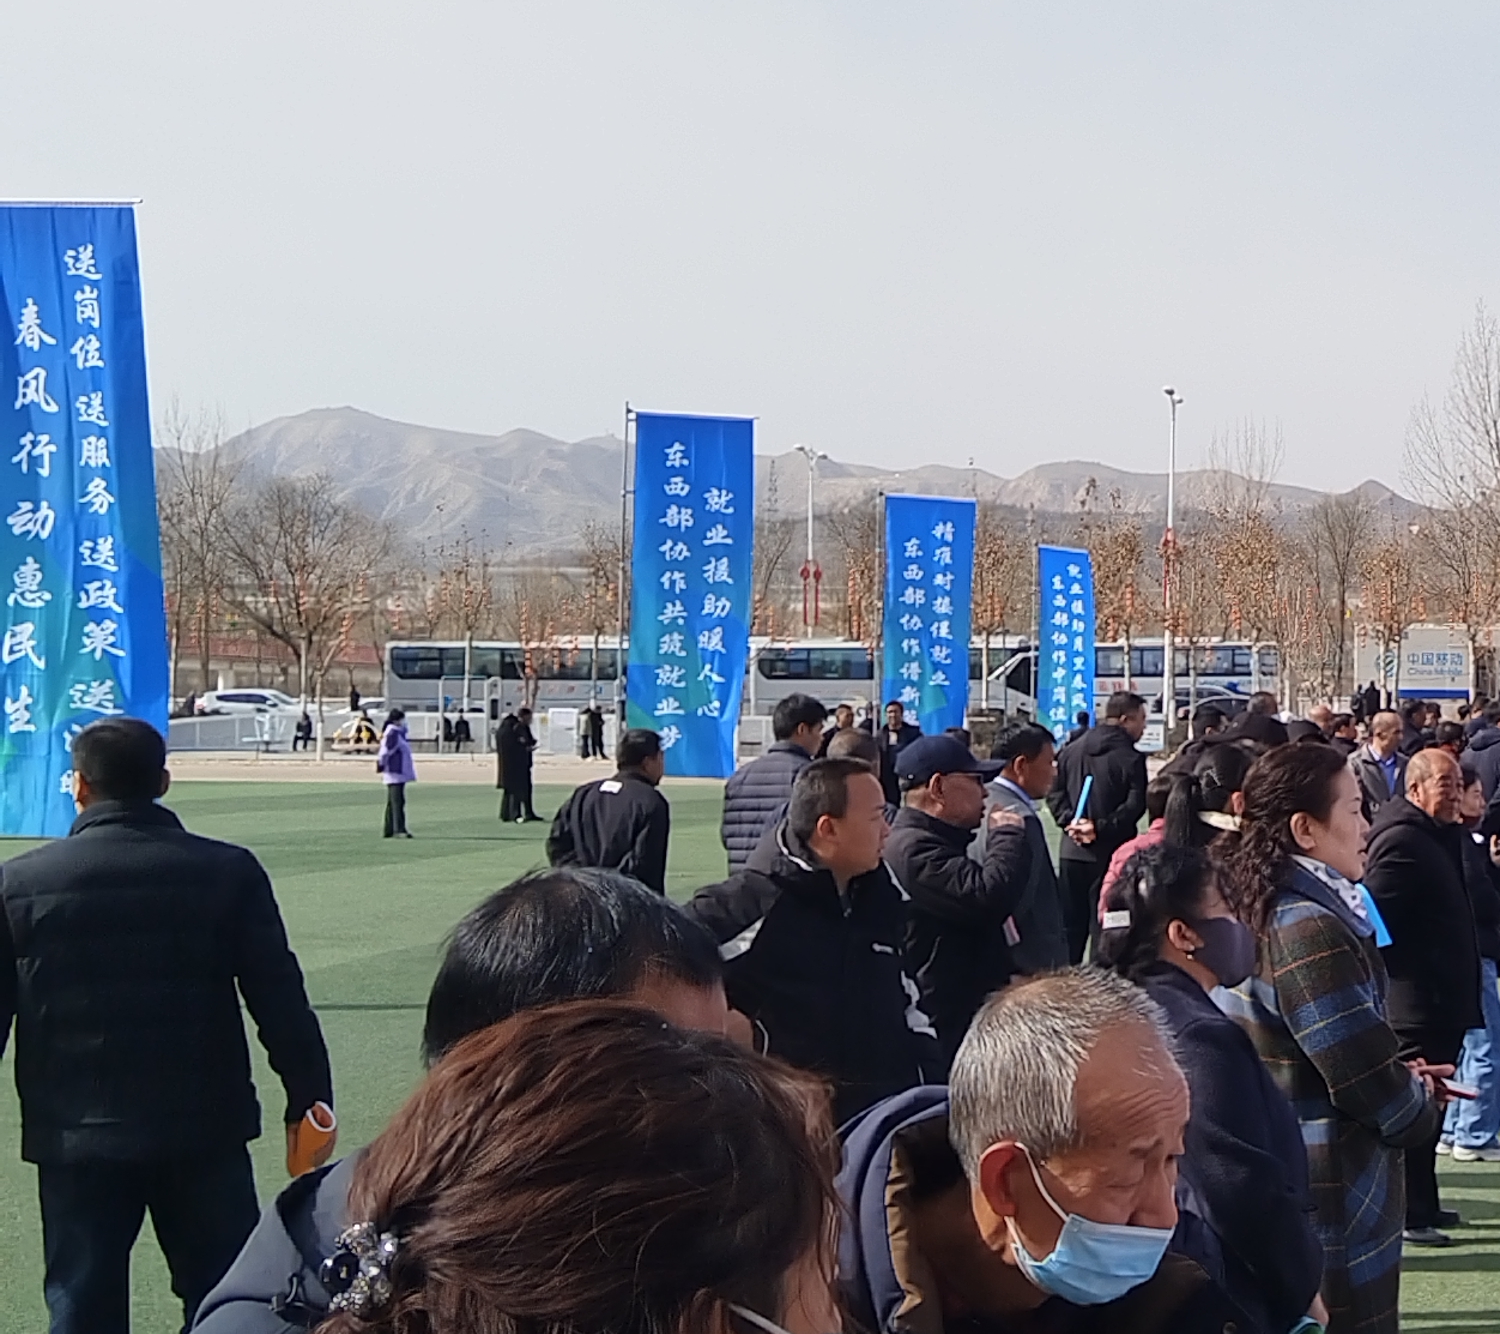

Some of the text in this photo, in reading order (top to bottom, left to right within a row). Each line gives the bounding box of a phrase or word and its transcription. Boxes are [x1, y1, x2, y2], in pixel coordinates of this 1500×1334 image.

[63, 242, 105, 372] 送岗位
[2, 297, 59, 735] 春风行动惠民生
[74, 390, 117, 517] 送服务
[74, 536, 127, 663] 送政策
[653, 440, 695, 751] 东西部协作共筑就业梦
[696, 485, 735, 718] 就业援助暖人心
[1407, 652, 1464, 666] 中国移动
[1407, 667, 1464, 676] China Mobile
